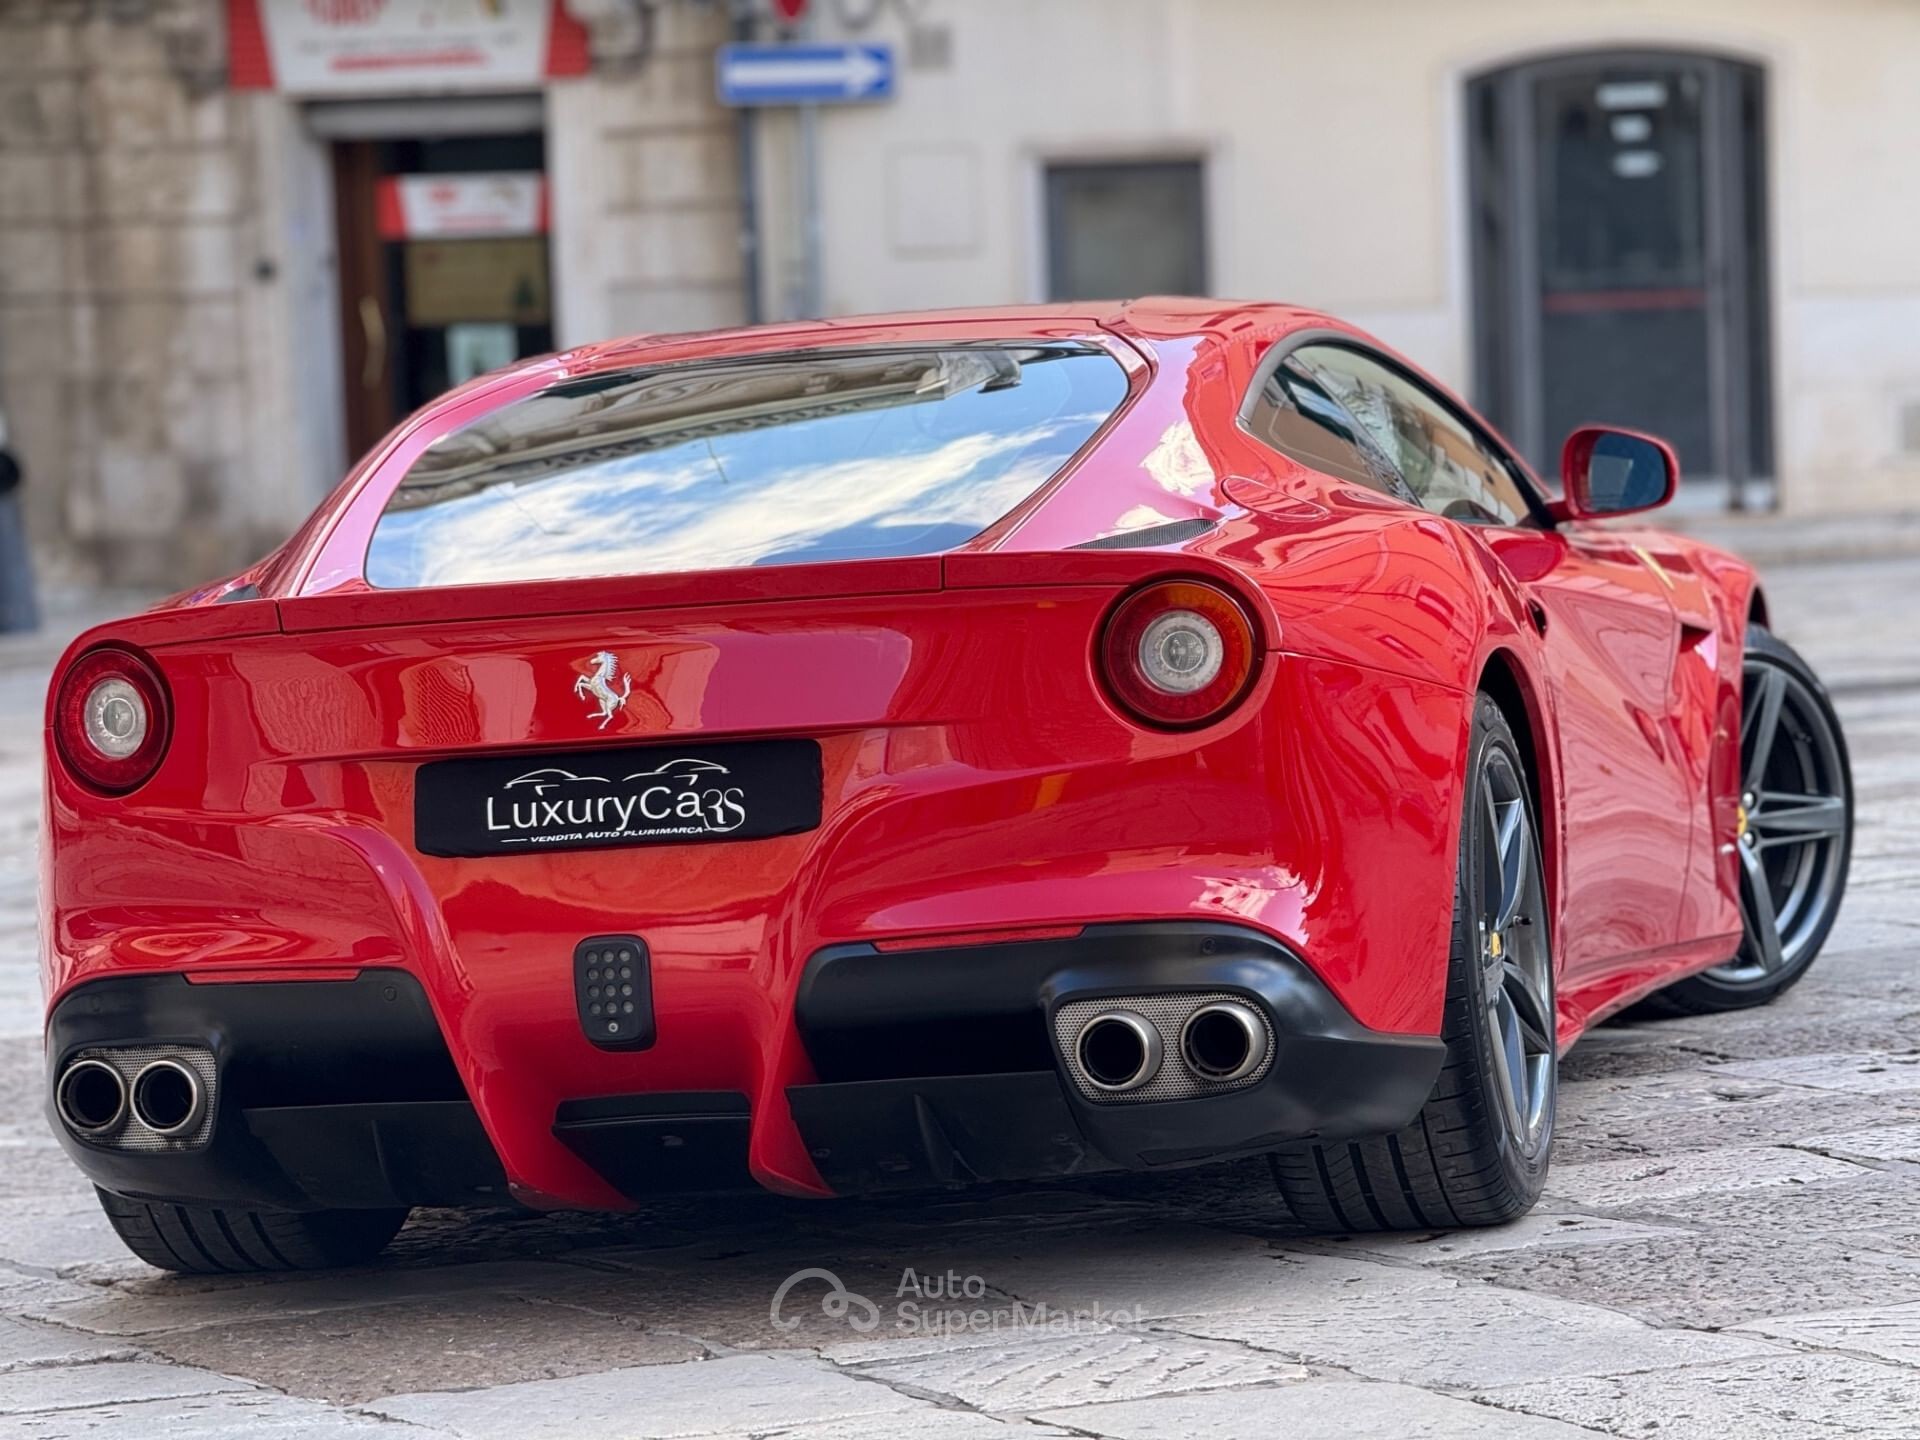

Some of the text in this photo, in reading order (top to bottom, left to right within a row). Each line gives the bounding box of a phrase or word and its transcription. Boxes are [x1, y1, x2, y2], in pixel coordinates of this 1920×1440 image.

[531, 826, 704, 843] VENDITA AUTO PLURIMARCA
